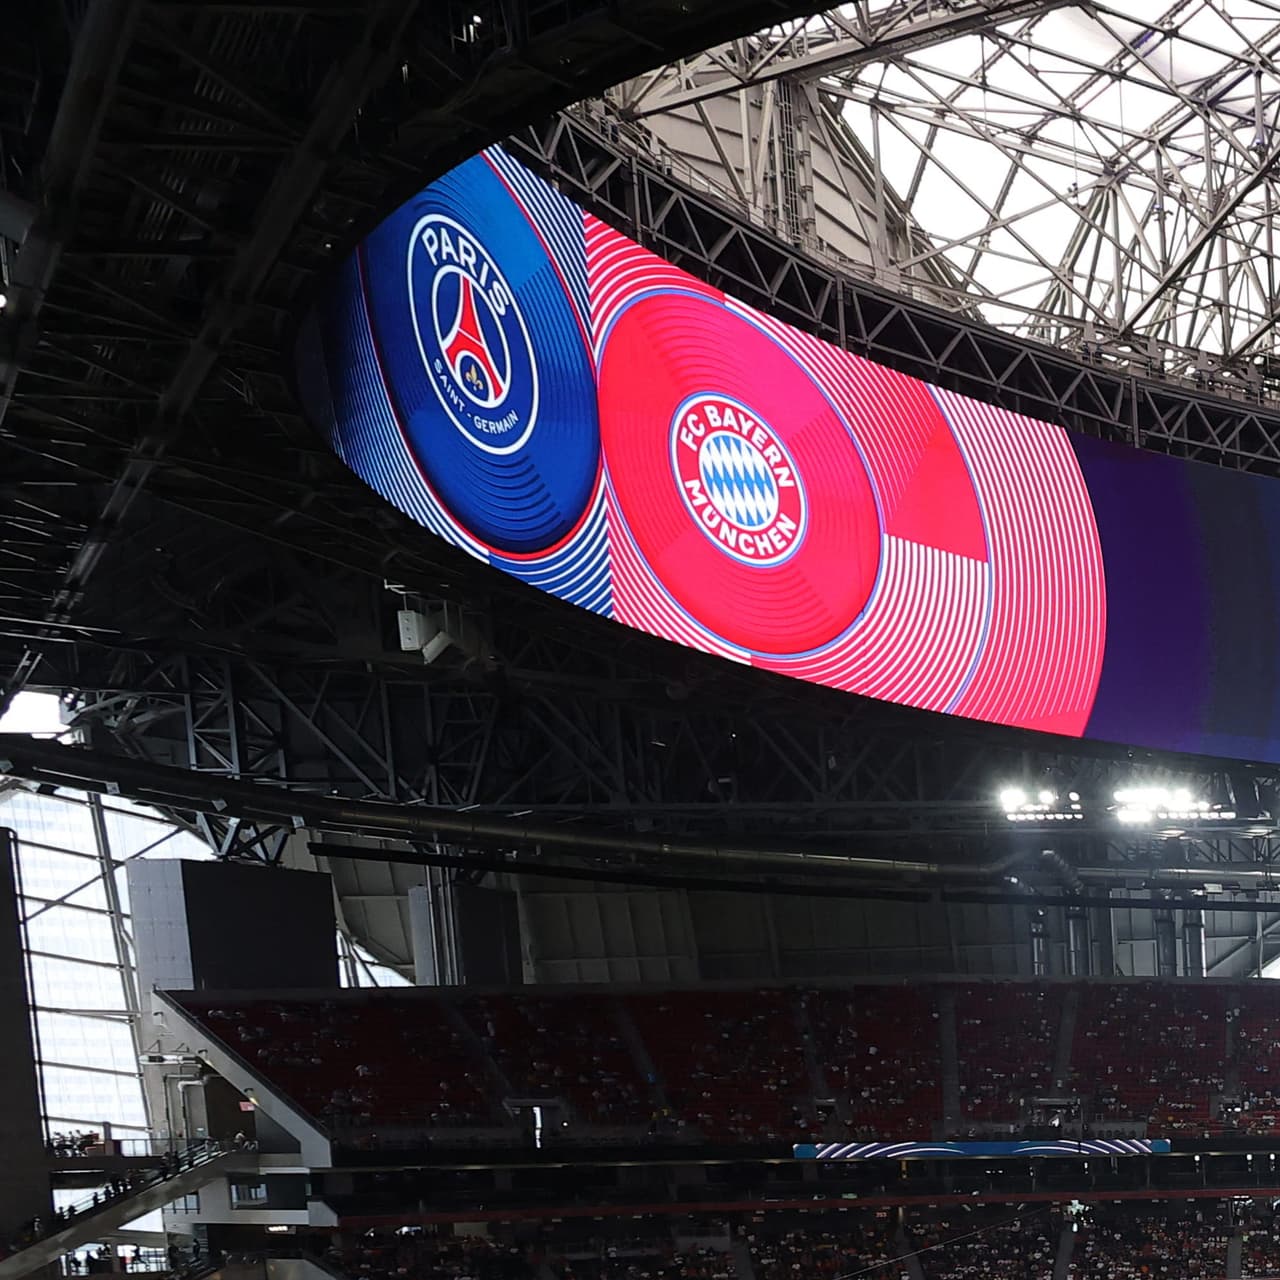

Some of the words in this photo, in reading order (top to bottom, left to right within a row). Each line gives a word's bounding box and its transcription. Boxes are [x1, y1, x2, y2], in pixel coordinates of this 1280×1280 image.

[422, 228, 510, 316] PARIS
[434, 358, 466, 412] SAINT
[473, 410, 519, 435] GERMAIN
[680, 413, 705, 452] FC
[703, 405, 795, 488] BAYERN
[685, 479, 796, 556] MÜNCHEN
